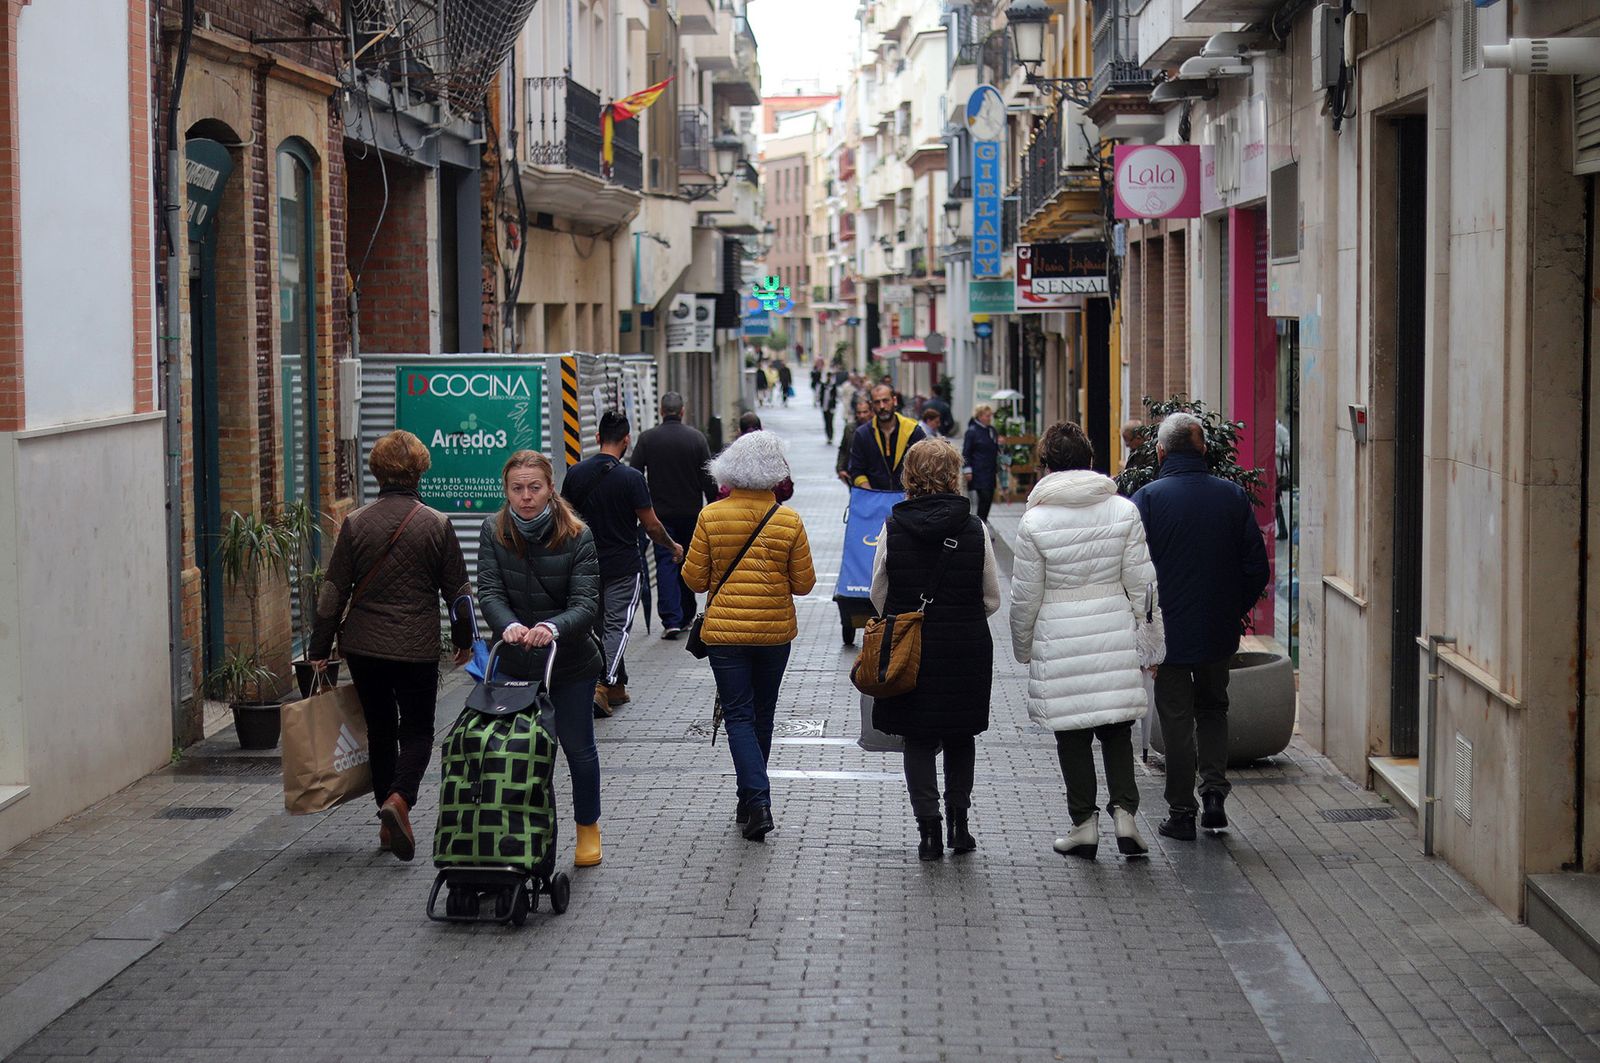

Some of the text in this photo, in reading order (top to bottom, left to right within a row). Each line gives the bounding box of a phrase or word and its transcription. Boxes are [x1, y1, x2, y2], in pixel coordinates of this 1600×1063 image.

[1128, 164, 1175, 186] Lala
[976, 145, 998, 273] GIRLADY
[1036, 279, 1105, 294] SENSAI
[431, 429, 508, 449] Arredo3
[464, 477, 495, 485] 915/620
[333, 749, 370, 773] adidas
